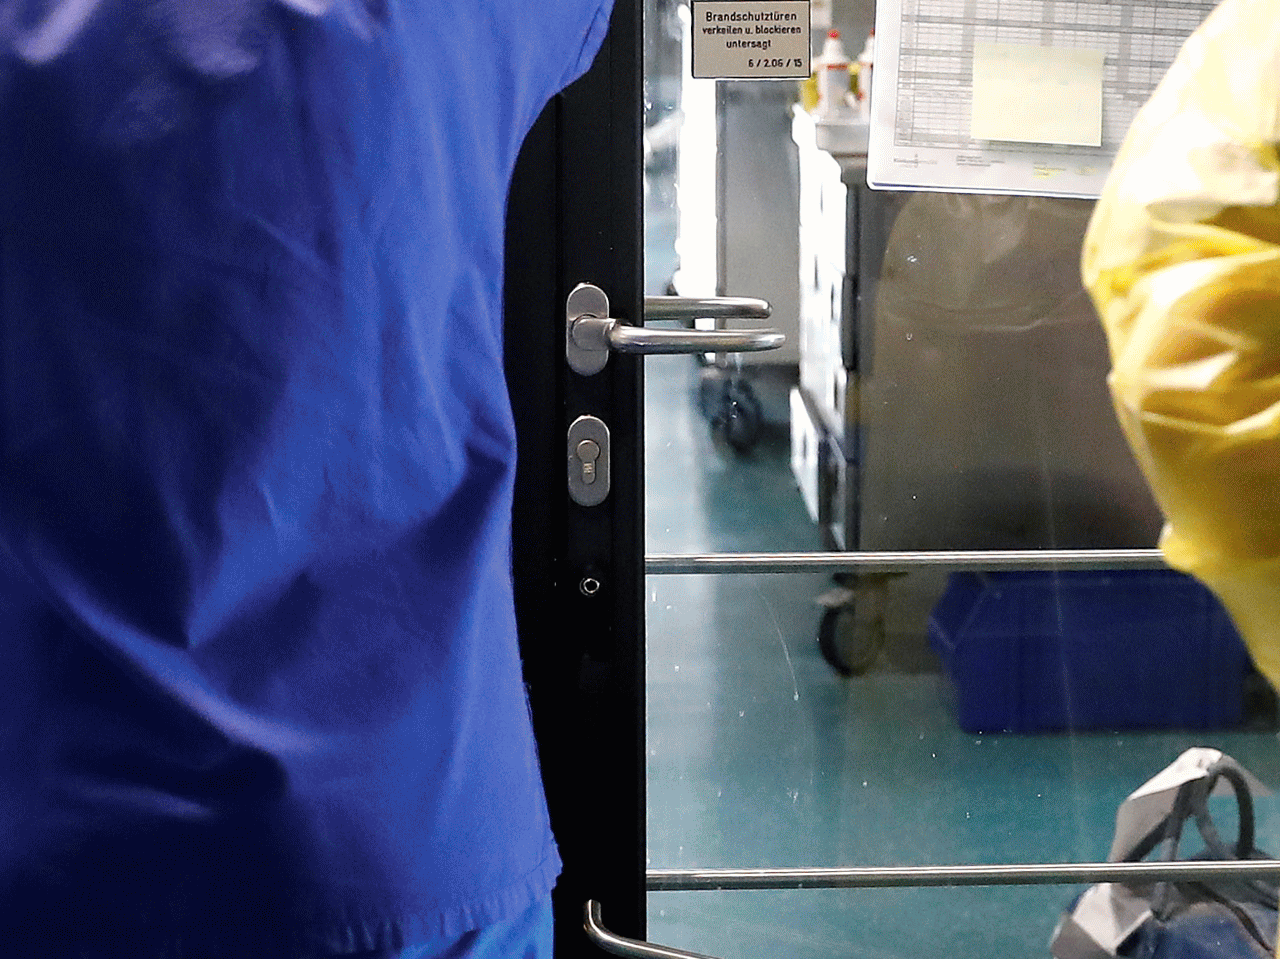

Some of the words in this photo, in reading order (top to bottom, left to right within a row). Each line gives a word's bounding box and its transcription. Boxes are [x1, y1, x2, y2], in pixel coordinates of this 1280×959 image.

[705, 11, 797, 22] Brandschutztüren
[702, 25, 743, 35] verkeilen
[744, 27, 754, 35] u.
[755, 24, 802, 35] blockieren
[726, 39, 772, 51] untersagt
